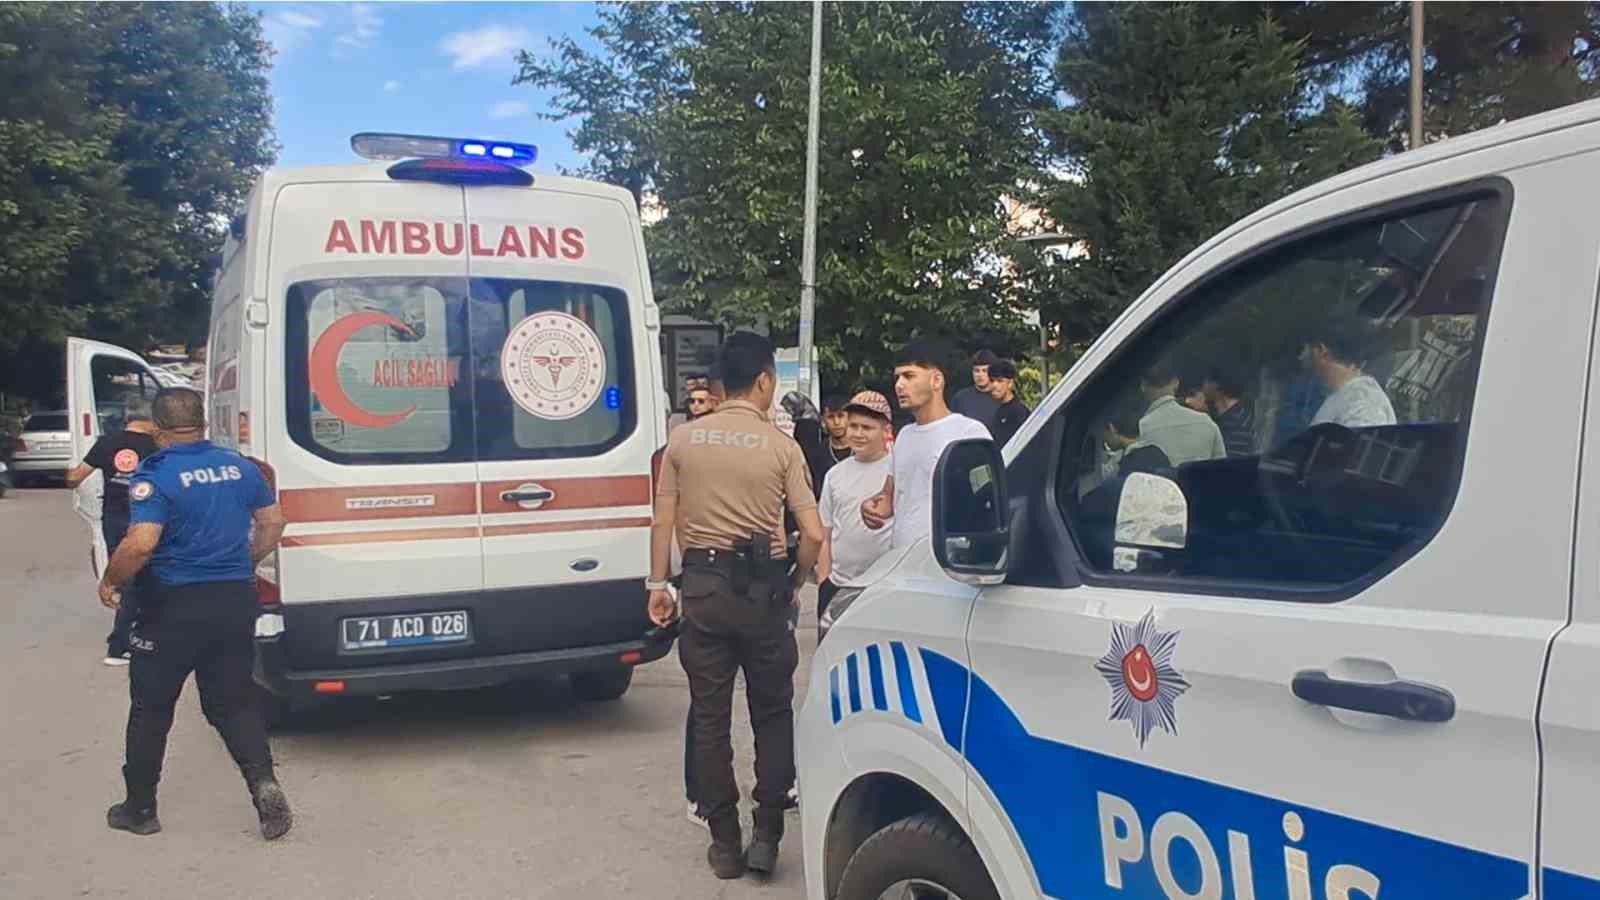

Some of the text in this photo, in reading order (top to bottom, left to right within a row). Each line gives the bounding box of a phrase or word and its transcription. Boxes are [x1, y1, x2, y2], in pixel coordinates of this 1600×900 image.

[326, 219, 585, 259] AMBULANS
[359, 615, 463, 640] 71 ACD 026
